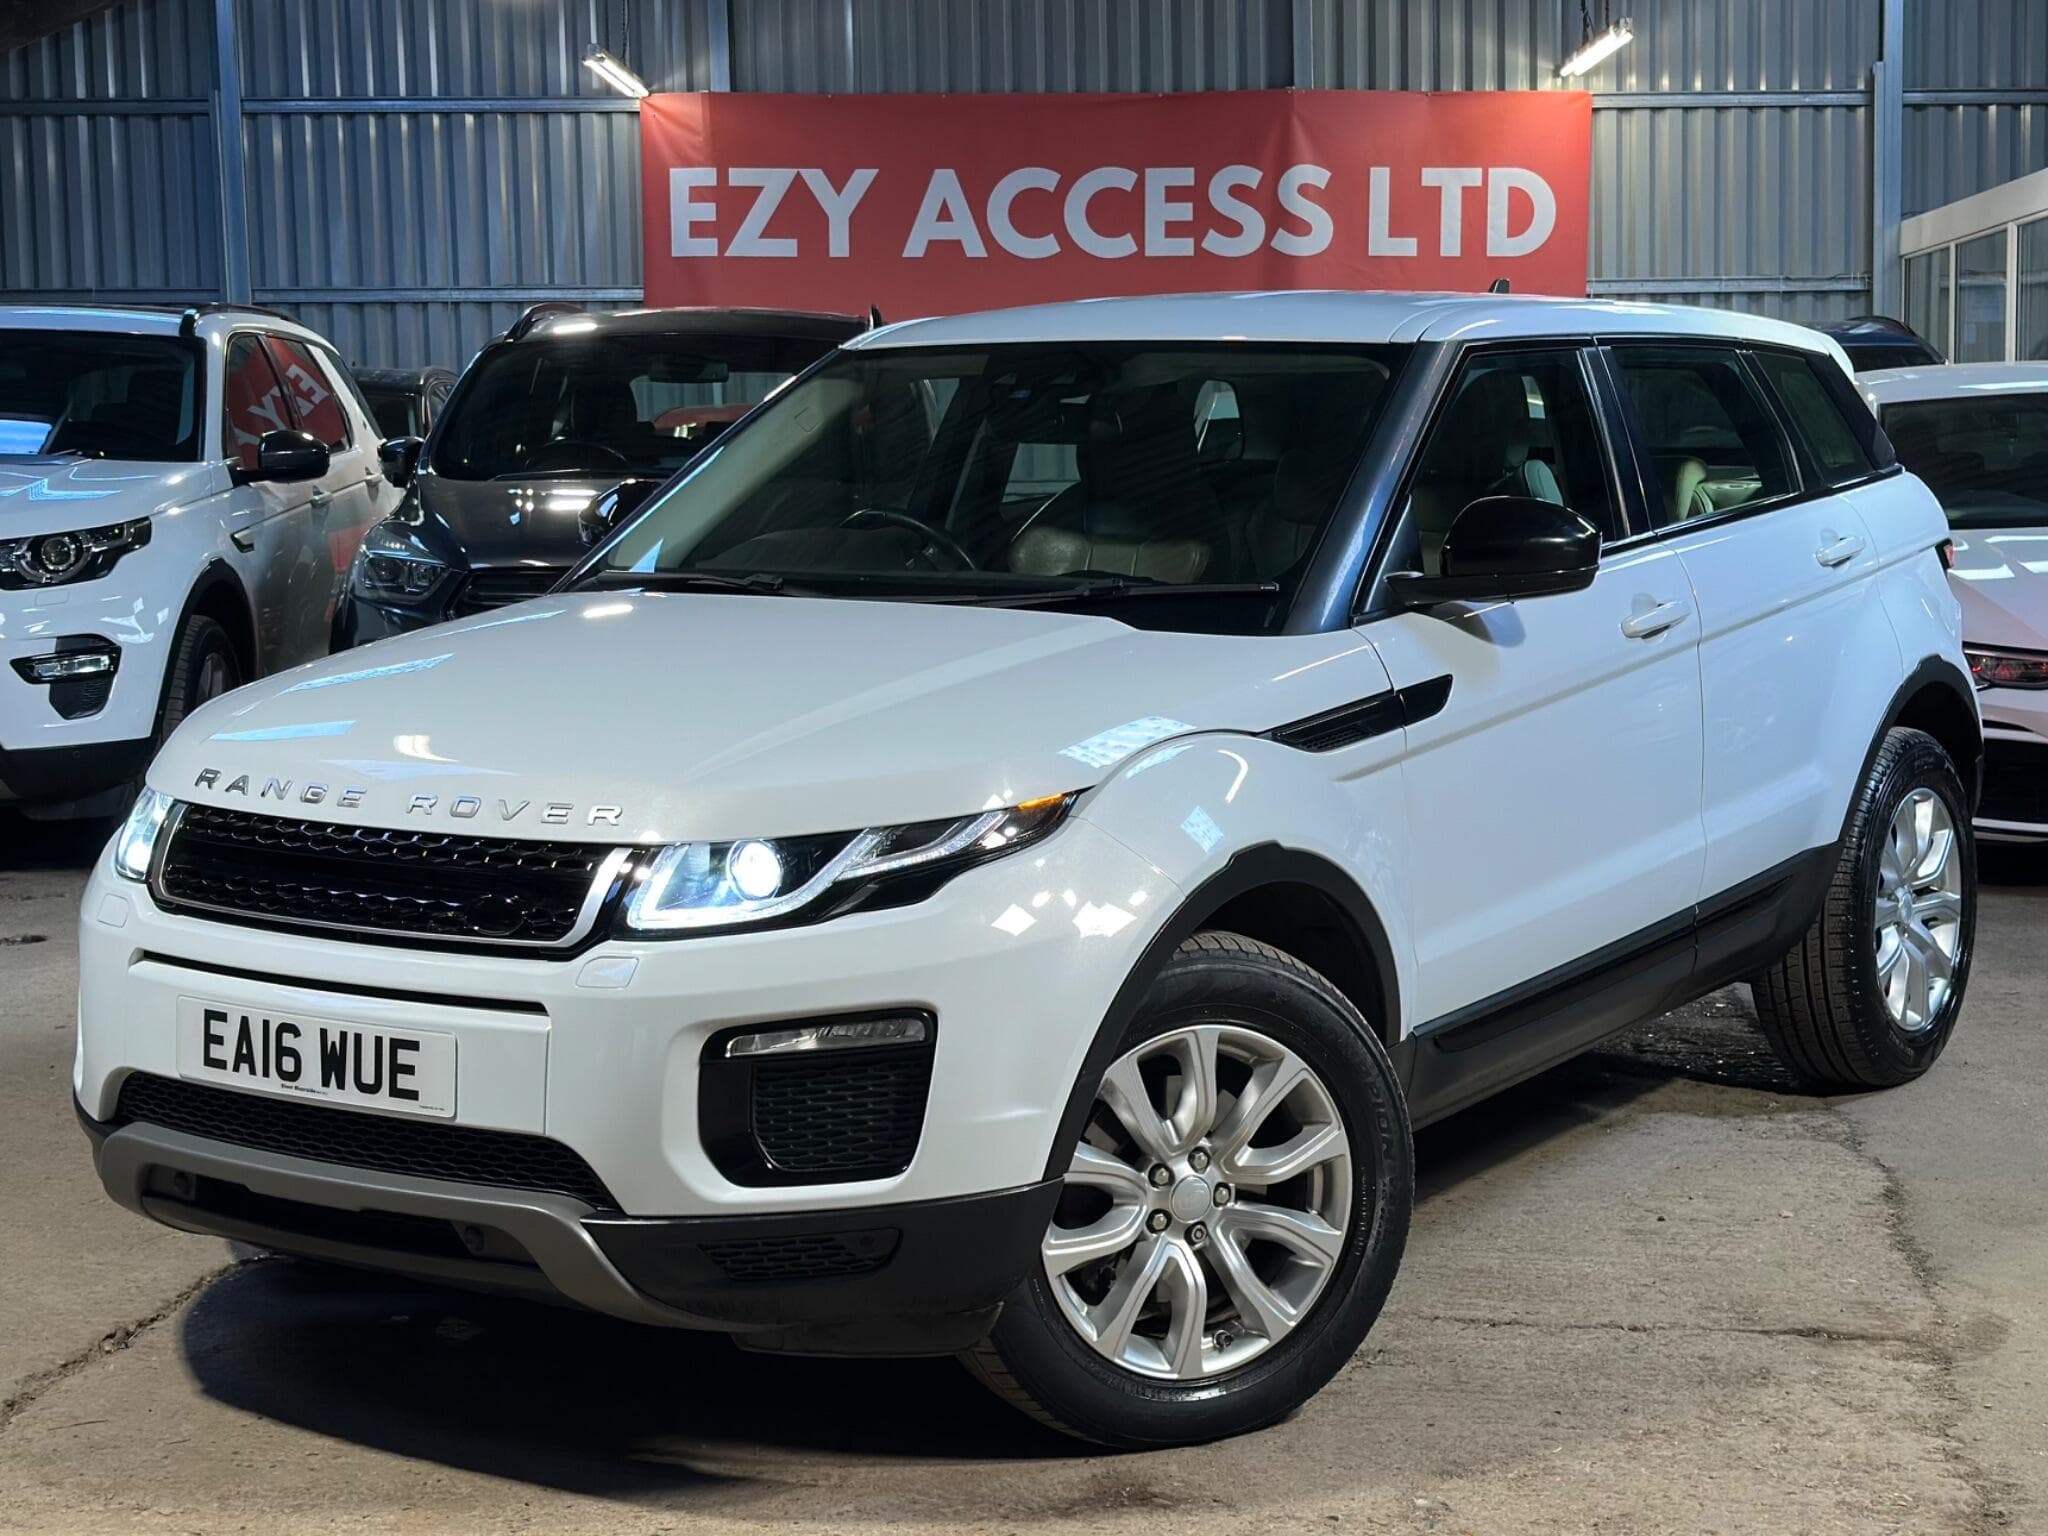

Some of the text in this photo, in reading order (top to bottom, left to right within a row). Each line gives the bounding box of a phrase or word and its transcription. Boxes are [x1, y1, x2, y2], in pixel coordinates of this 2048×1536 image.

[669, 164, 1557, 260] EZY ACCESS LTD
[194, 767, 623, 826] RANGE ROVER
[203, 1008, 421, 1101] EA16 WUE
